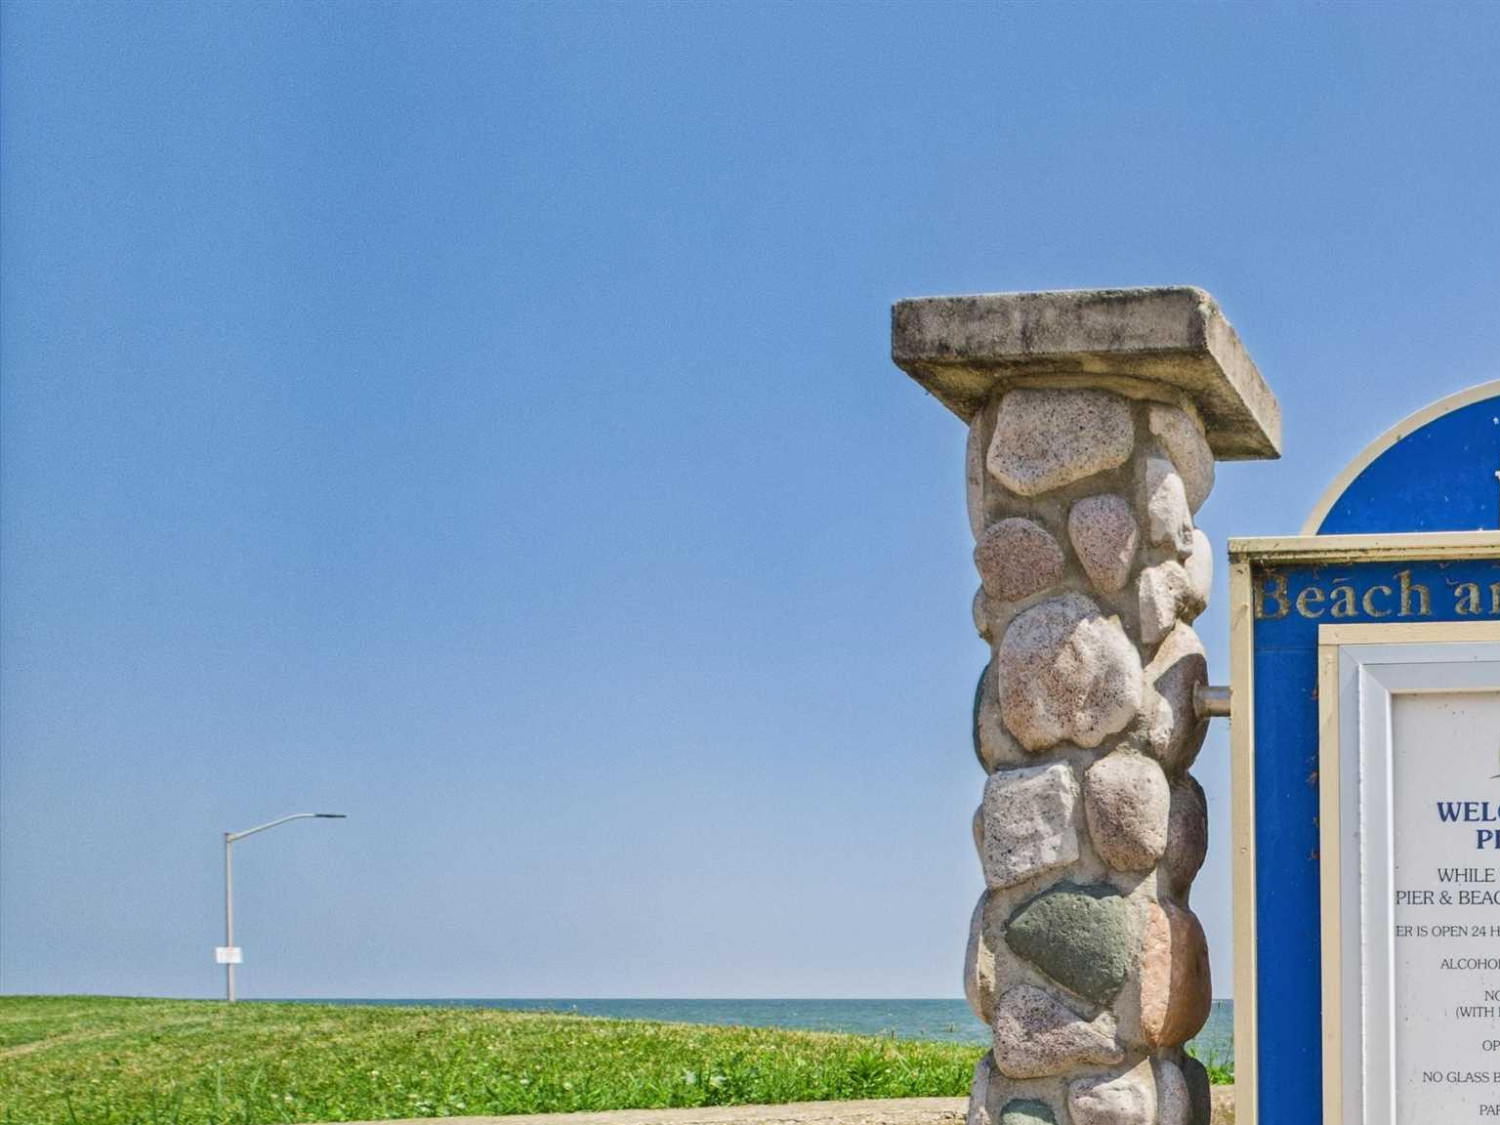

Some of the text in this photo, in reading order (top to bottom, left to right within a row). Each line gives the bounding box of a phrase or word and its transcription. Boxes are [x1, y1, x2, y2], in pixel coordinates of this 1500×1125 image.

[1253, 570, 1433, 620] Beach
[1438, 868, 1495, 882] WHILE
[1396, 891, 1434, 905] PIER
[1439, 891, 1453, 905] &
[1417, 926, 1428, 937] IS
[1432, 926, 1468, 937] OPEN
[1472, 926, 1486, 937] 24
[1456, 1006, 1494, 1018] (WITH
[1423, 1071, 1443, 1082] NO
[1447, 1072, 1490, 1083] GLASS
